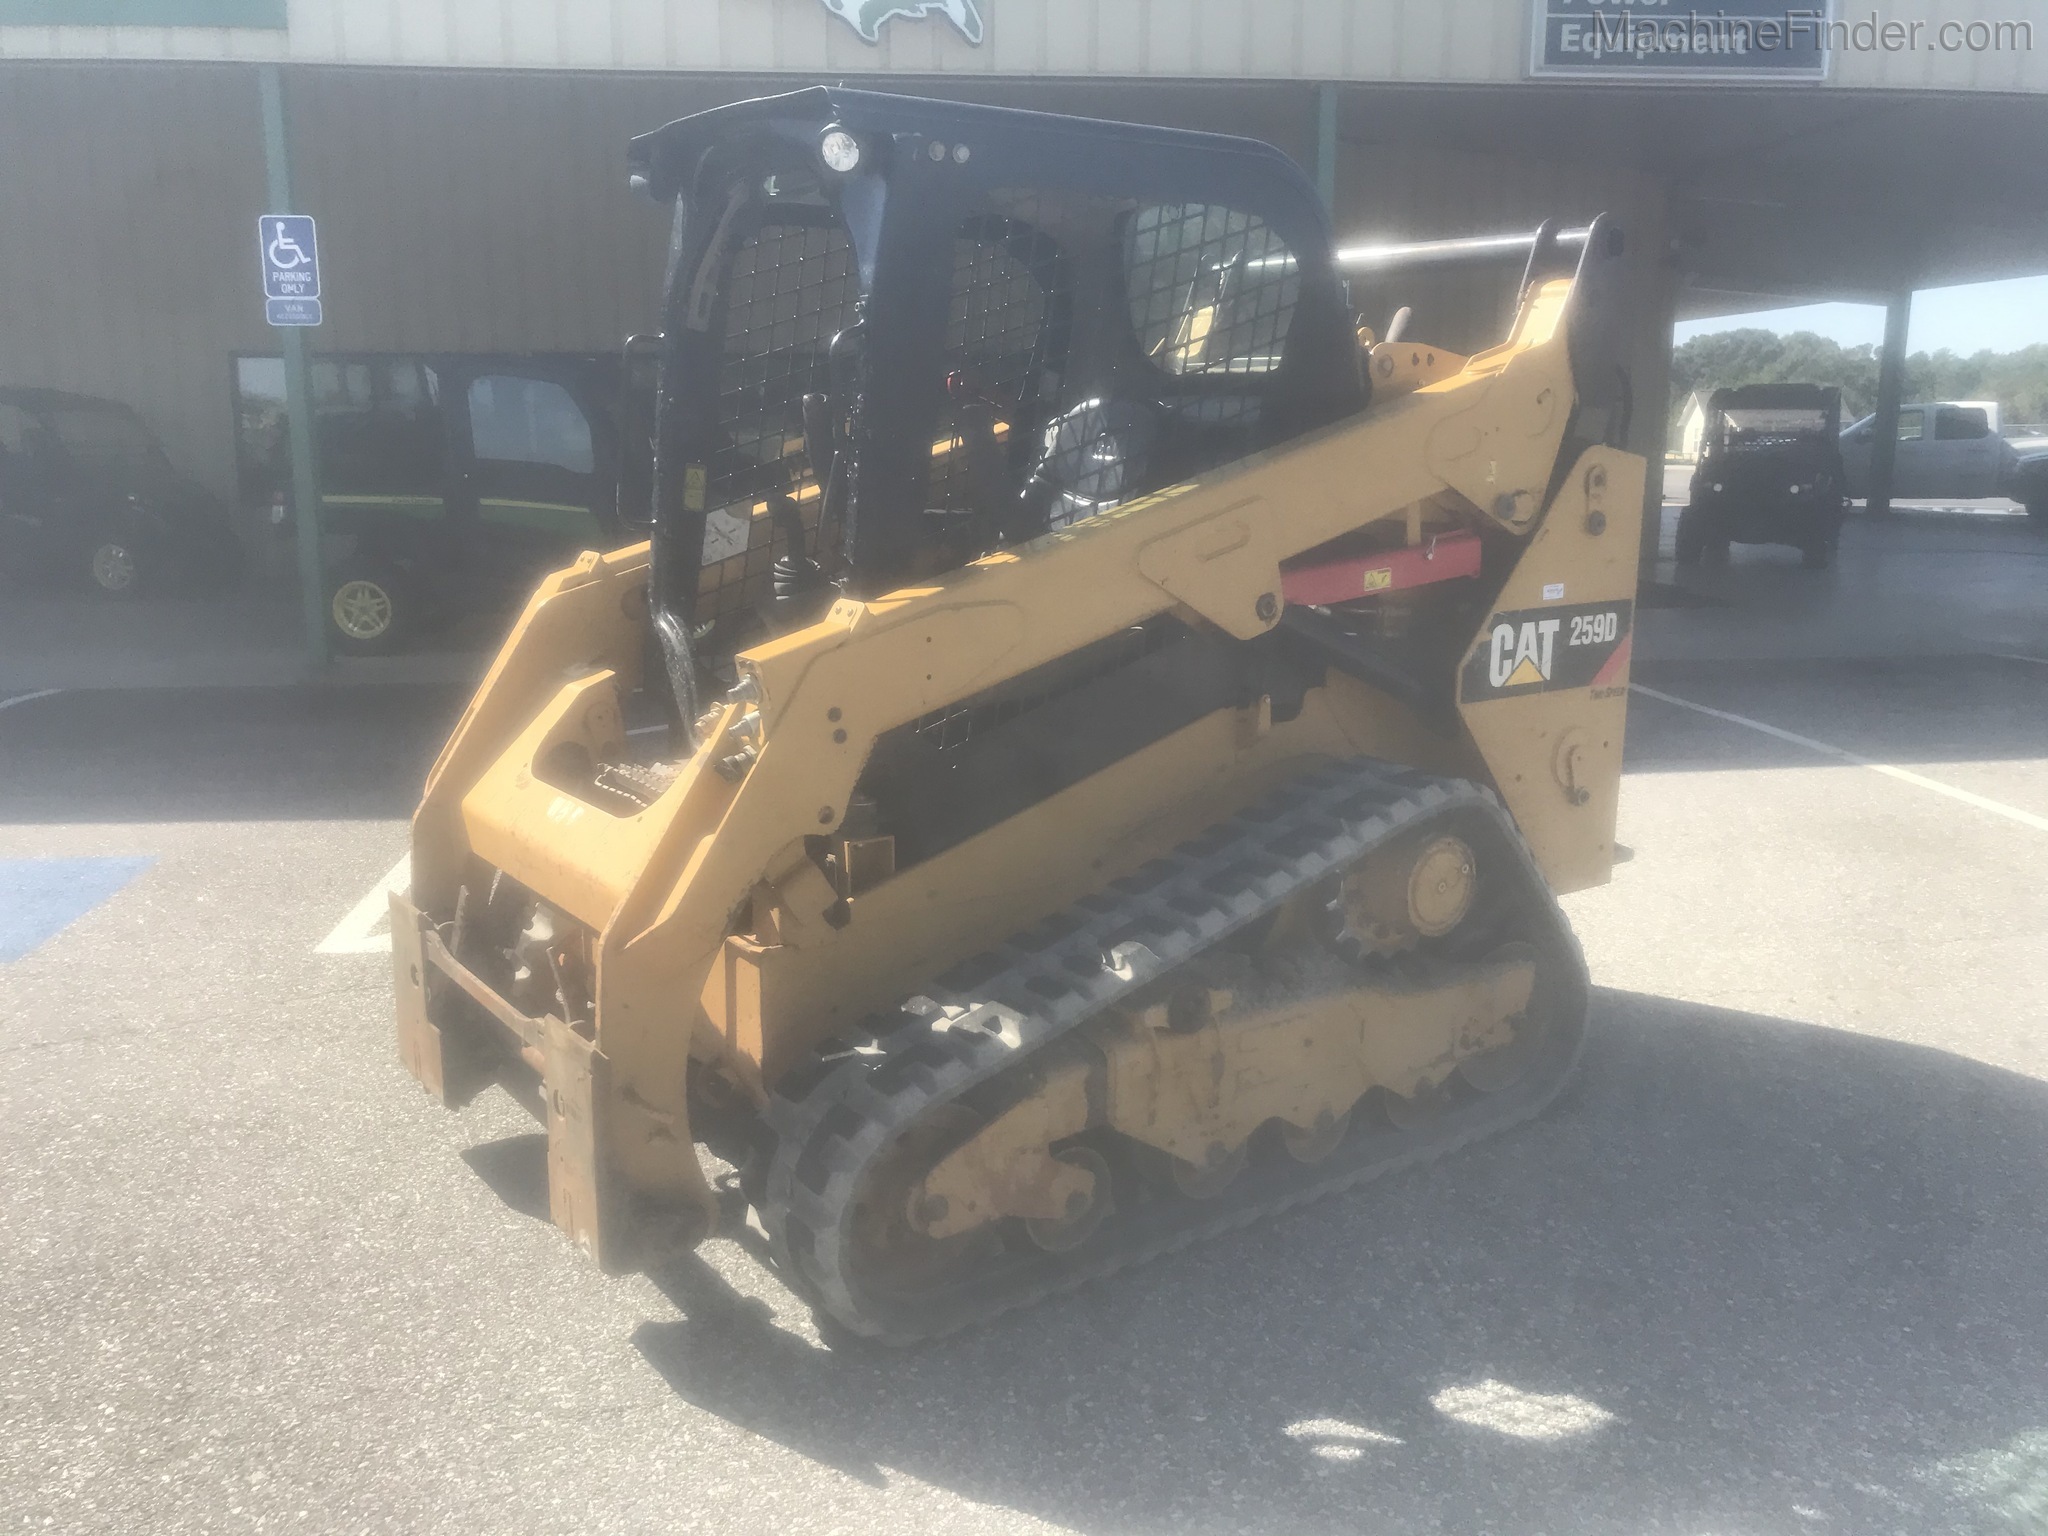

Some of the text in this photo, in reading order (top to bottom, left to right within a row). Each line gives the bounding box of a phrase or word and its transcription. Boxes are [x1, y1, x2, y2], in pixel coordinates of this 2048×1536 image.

[1560, 23, 1747, 59] Equipment
[272, 271, 312, 282] PARKING
[281, 283, 305, 294] ONLY
[1489, 612, 1617, 687] CAT 259D
